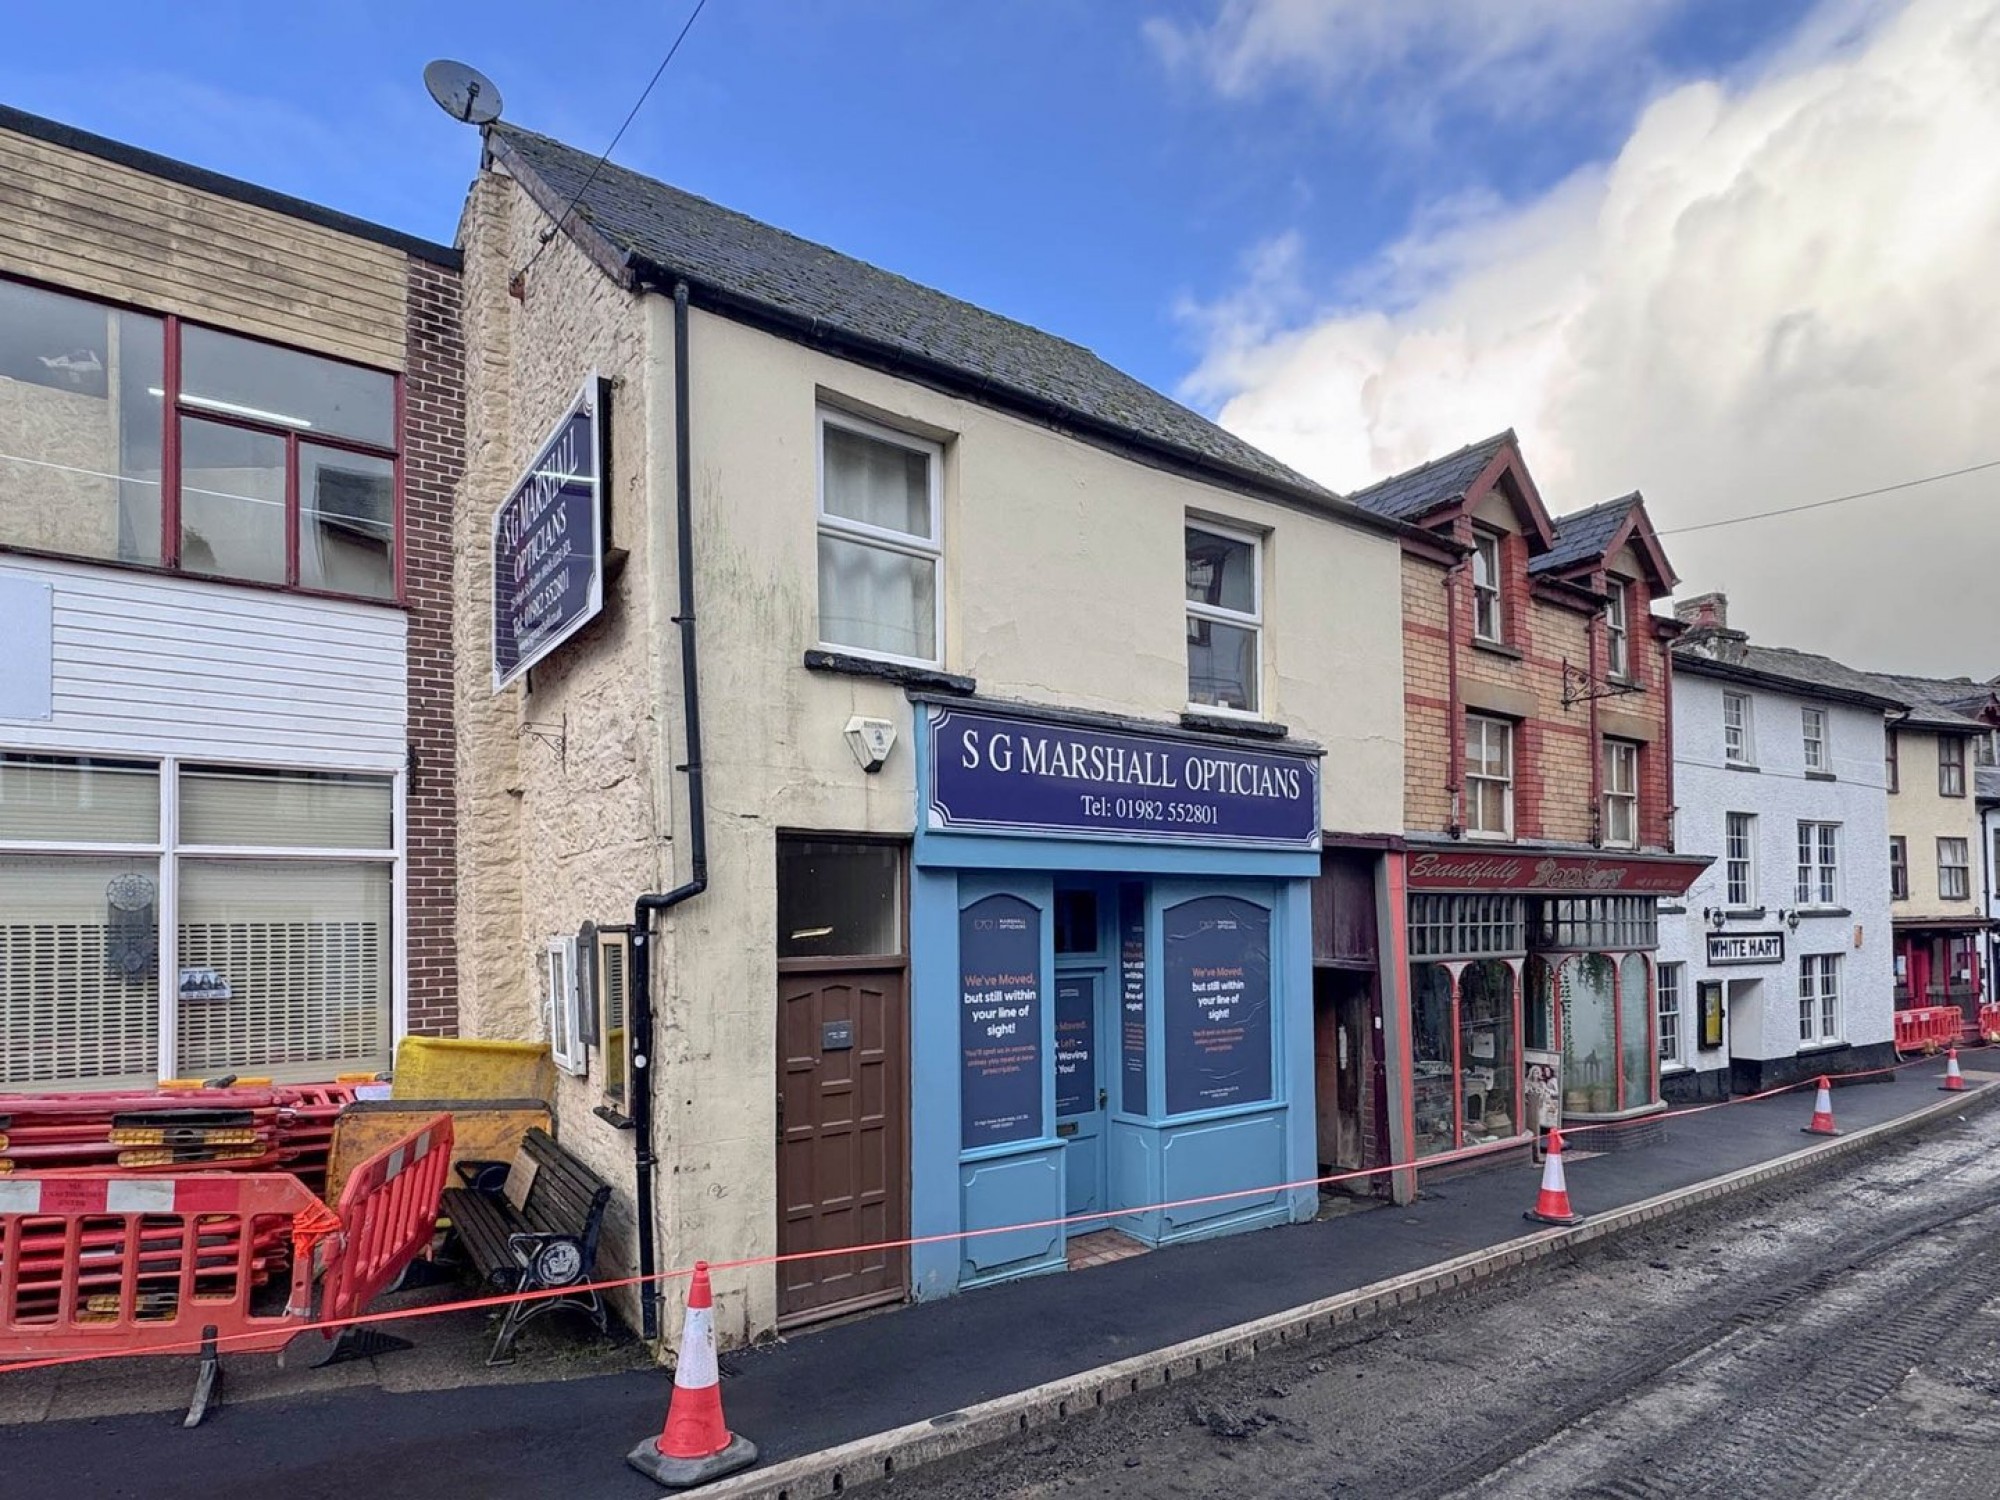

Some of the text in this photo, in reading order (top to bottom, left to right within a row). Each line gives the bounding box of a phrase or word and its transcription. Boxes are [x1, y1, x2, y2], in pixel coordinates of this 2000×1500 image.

[519, 425, 578, 534] MARSHALL
[514, 501, 567, 583] OPTICIANS
[962, 729, 1301, 800] S G MARSHALL OPTICIANS
[1081, 794, 1218, 824] Tel: 01982 552801
[1410, 853, 1523, 887] Beautifully
[1710, 938, 1779, 958] WHITE HART
[1192, 967, 1216, 977] We've
[965, 974, 997, 987] We've
[1192, 979, 1245, 993] but still within
[964, 989, 1036, 1004] but still within
[1198, 993, 1240, 1008] your line of
[972, 1004, 1029, 1022] your line of
[1208, 1008, 1230, 1021] sight!
[986, 1022, 1016, 1038] sight!
[1058, 1050, 1088, 1061] Waving
[1058, 1063, 1076, 1074] You!
